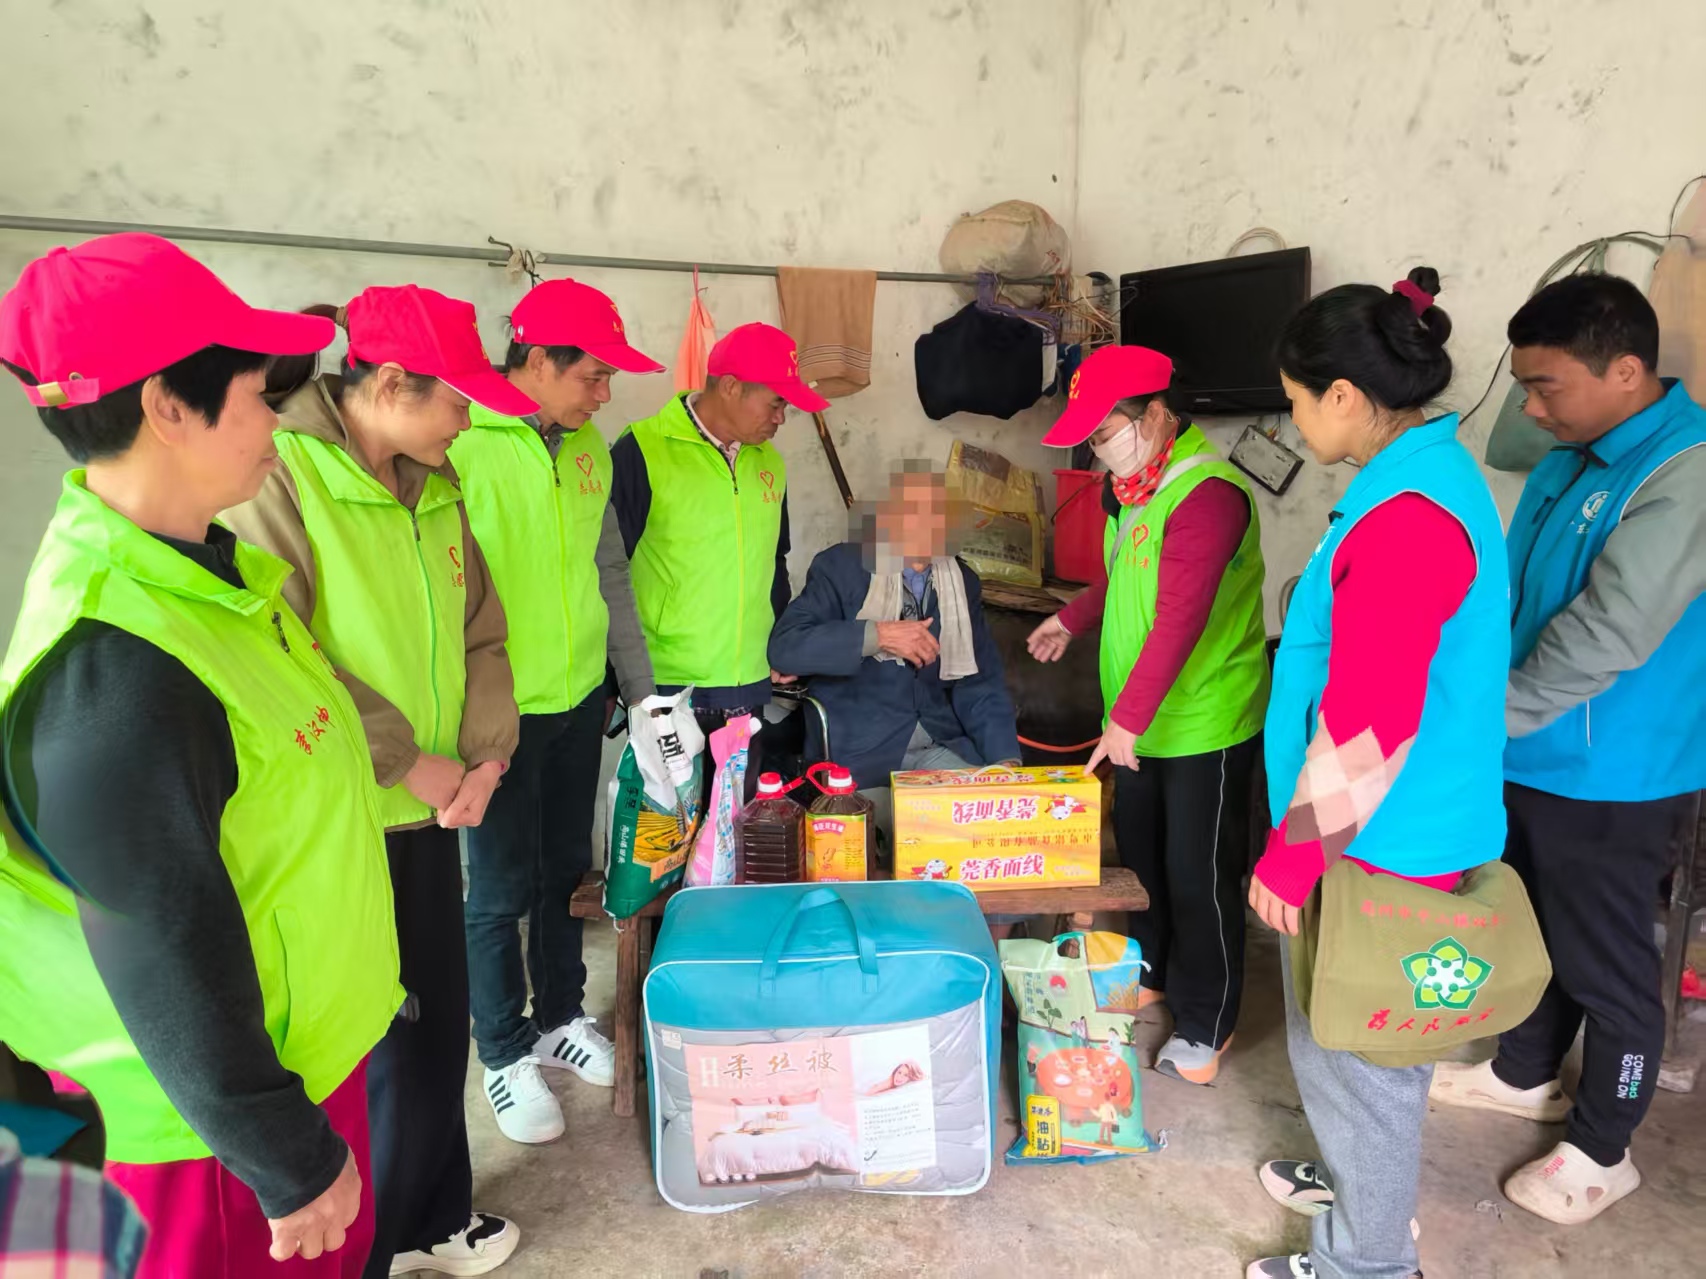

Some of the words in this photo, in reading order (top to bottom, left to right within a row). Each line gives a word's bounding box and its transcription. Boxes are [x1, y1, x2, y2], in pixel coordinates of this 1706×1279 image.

[954, 797, 1040, 824] 莞香面线
[961, 854, 1044, 881] 莞香面线
[723, 1048, 839, 1080] 柔丝被
[1619, 1053, 1634, 1083] GOING
[1631, 1054, 1644, 1081] COME
[1616, 1084, 1629, 1099] ON
